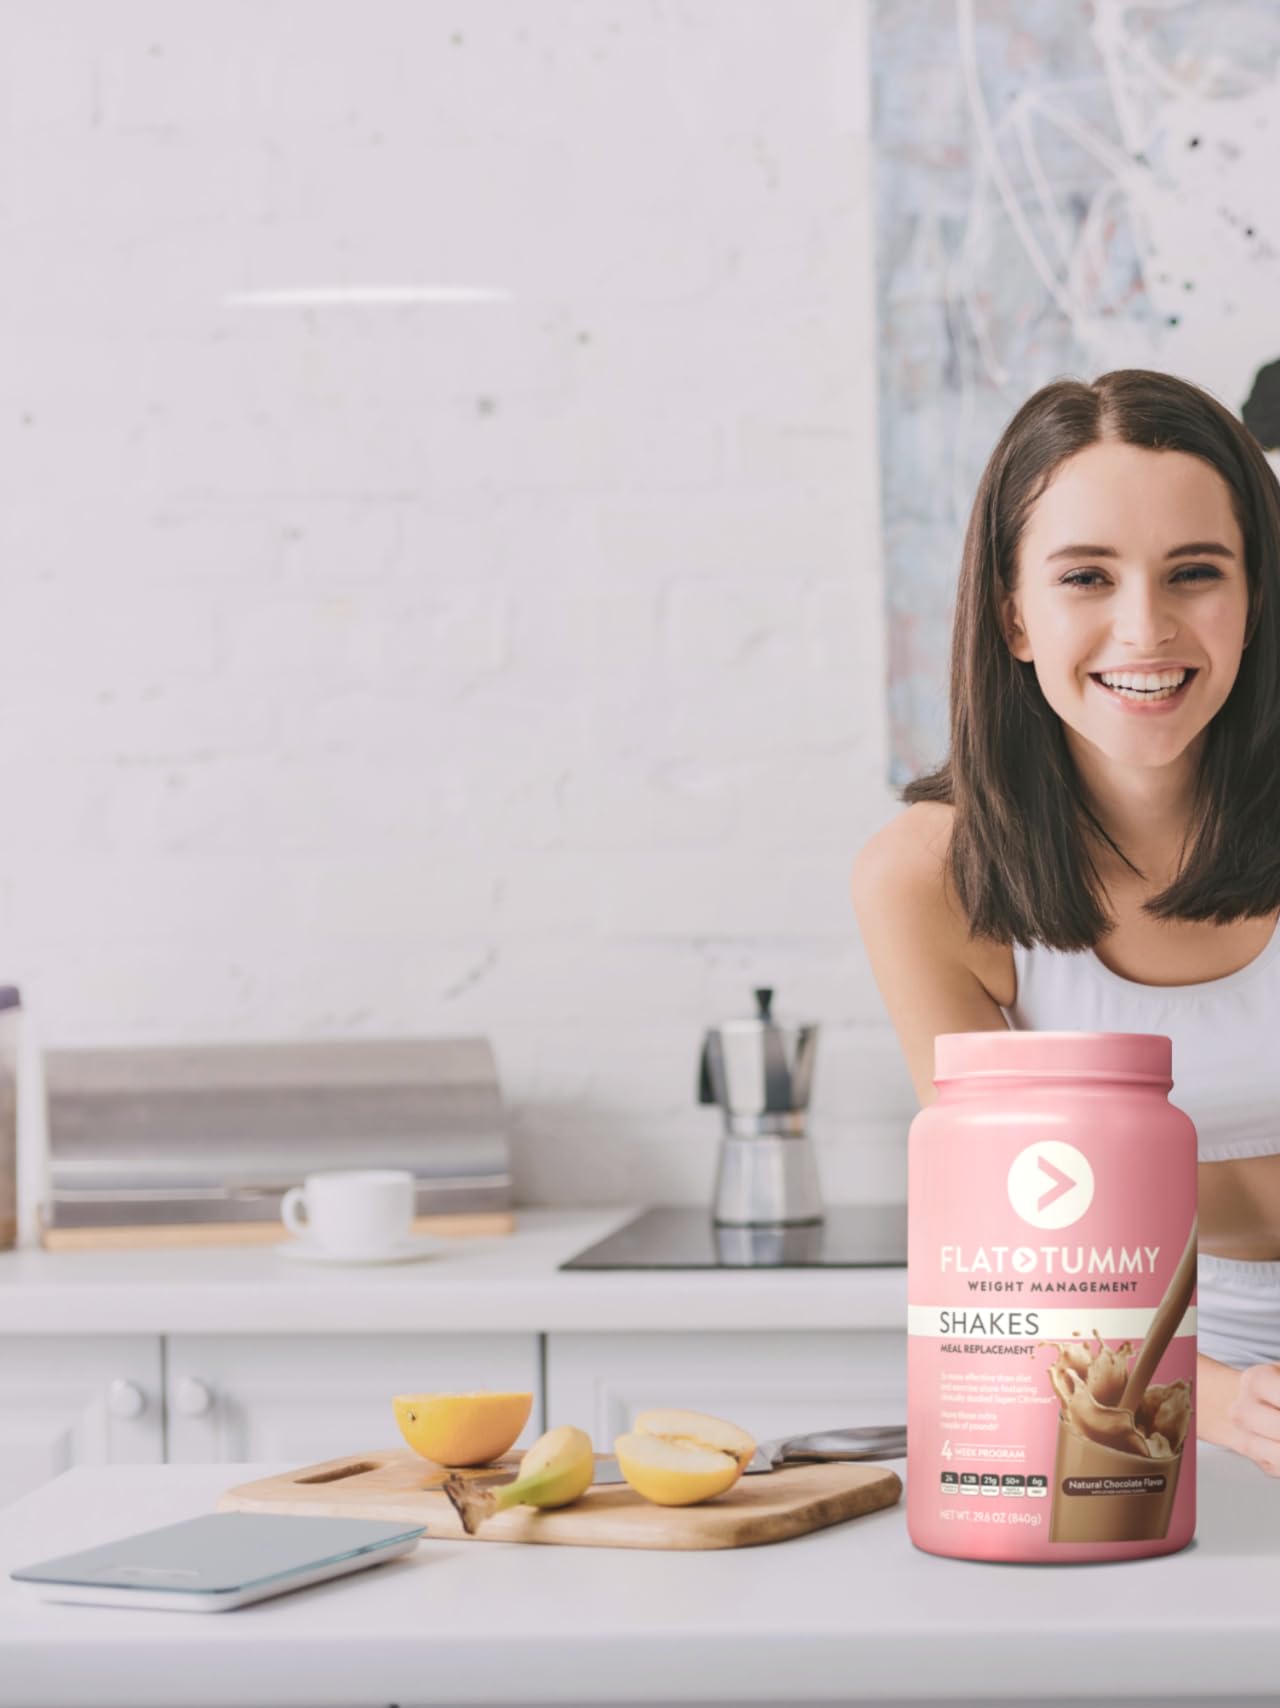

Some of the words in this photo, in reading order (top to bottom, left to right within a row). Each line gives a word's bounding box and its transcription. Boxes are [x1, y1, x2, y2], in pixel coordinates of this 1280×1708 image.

[1040, 1246, 1160, 1274] TUMMY
[968, 1281, 1024, 1292] WEIGHT
[1030, 1281, 1138, 1292] MANAGEMENT
[940, 1311, 1039, 1335] SHAKES
[941, 1344, 962, 1353] MEAL
[964, 1345, 1035, 1354] REPLACEMENT
[941, 1440, 953, 1461] 4
[955, 1447, 978, 1457] WEEK
[978, 1449, 1025, 1458] PROGRAM
[1069, 1480, 1102, 1489] Natural
[1103, 1479, 1141, 1489] Chocolate
[1143, 1478, 1163, 1487] Flavor
[941, 1509, 957, 1520] NET
[992, 1512, 1006, 1523] OZ
[1007, 1513, 1042, 1526] (840g)
